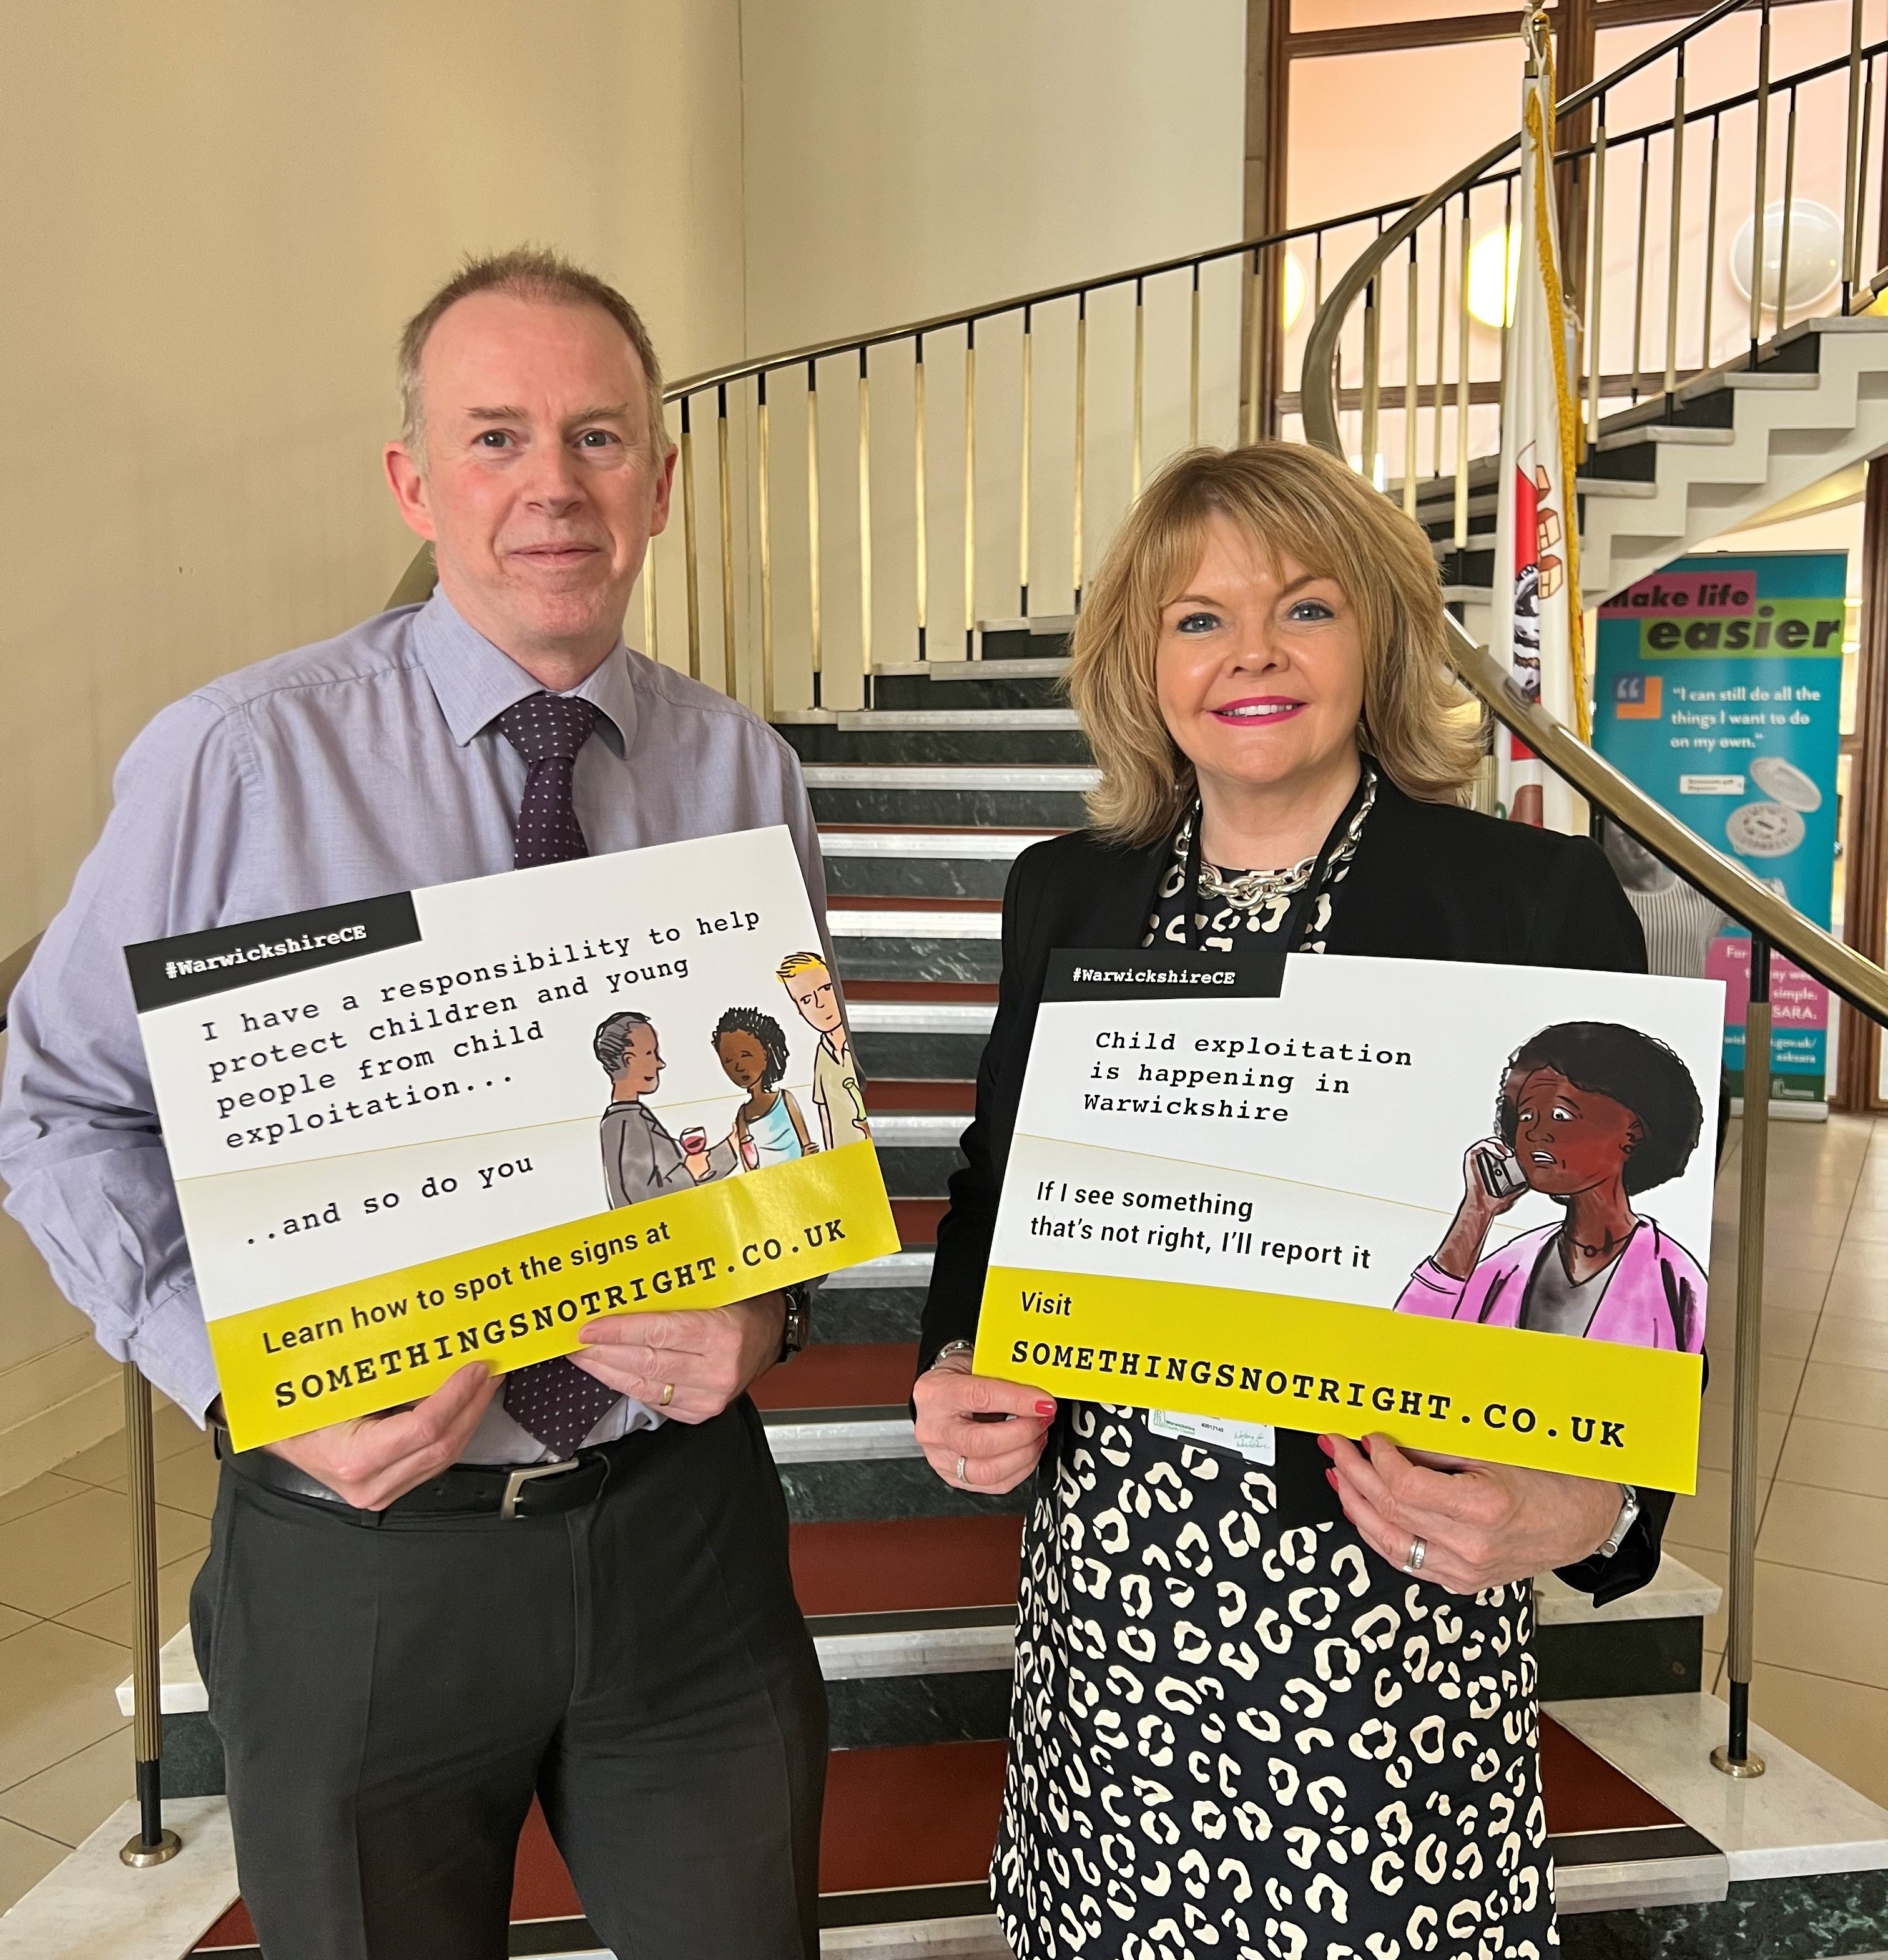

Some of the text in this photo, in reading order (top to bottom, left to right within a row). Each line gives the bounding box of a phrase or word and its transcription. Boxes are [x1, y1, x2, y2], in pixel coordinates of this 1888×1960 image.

[1697, 584, 1749, 607] life
[1647, 605, 1841, 652] easier
[1689, 690, 1715, 702] can
[1719, 686, 1746, 701] still
[1750, 687, 1770, 701] do
[1773, 687, 1791, 701] all
[1795, 687, 1821, 702] the
[1671, 711, 1811, 730] things I want to do
[1670, 737, 1690, 748] on
[1693, 737, 1716, 753] my
[165, 925, 367, 979] #WarwickshireCE
[202, 911, 759, 1041] I have a responsibility to help
[1073, 967, 1236, 984] #WarwickshireCE
[209, 959, 689, 1084] protect children and young
[217, 1021, 544, 1119] people from child
[1096, 1031, 1412, 1066] Child exploitation
[1090, 1061, 1349, 1094] is happening in
[227, 1074, 511, 1148] exploitation...
[1084, 1094, 1288, 1122] Warwickshire
[363, 1193, 399, 1214] so
[421, 1177, 458, 1198] do
[478, 1157, 533, 1189] you
[1037, 1180, 1253, 1222] If I see something
[1101, 1225, 1139, 1243] not
[1147, 1225, 1211, 1254] right,
[1261, 1241, 1342, 1265] report
[1352, 1245, 1371, 1269] it
[263, 1222, 671, 1354] Learn how to spot the signs at
[1021, 1291, 1072, 1316] Visit
[275, 1218, 847, 1408] SOMETHINGSNOTRIGHT.CO.UK
[1011, 1340, 1625, 1448] SOMETHINGSNOTRIGHT.CO.UK
